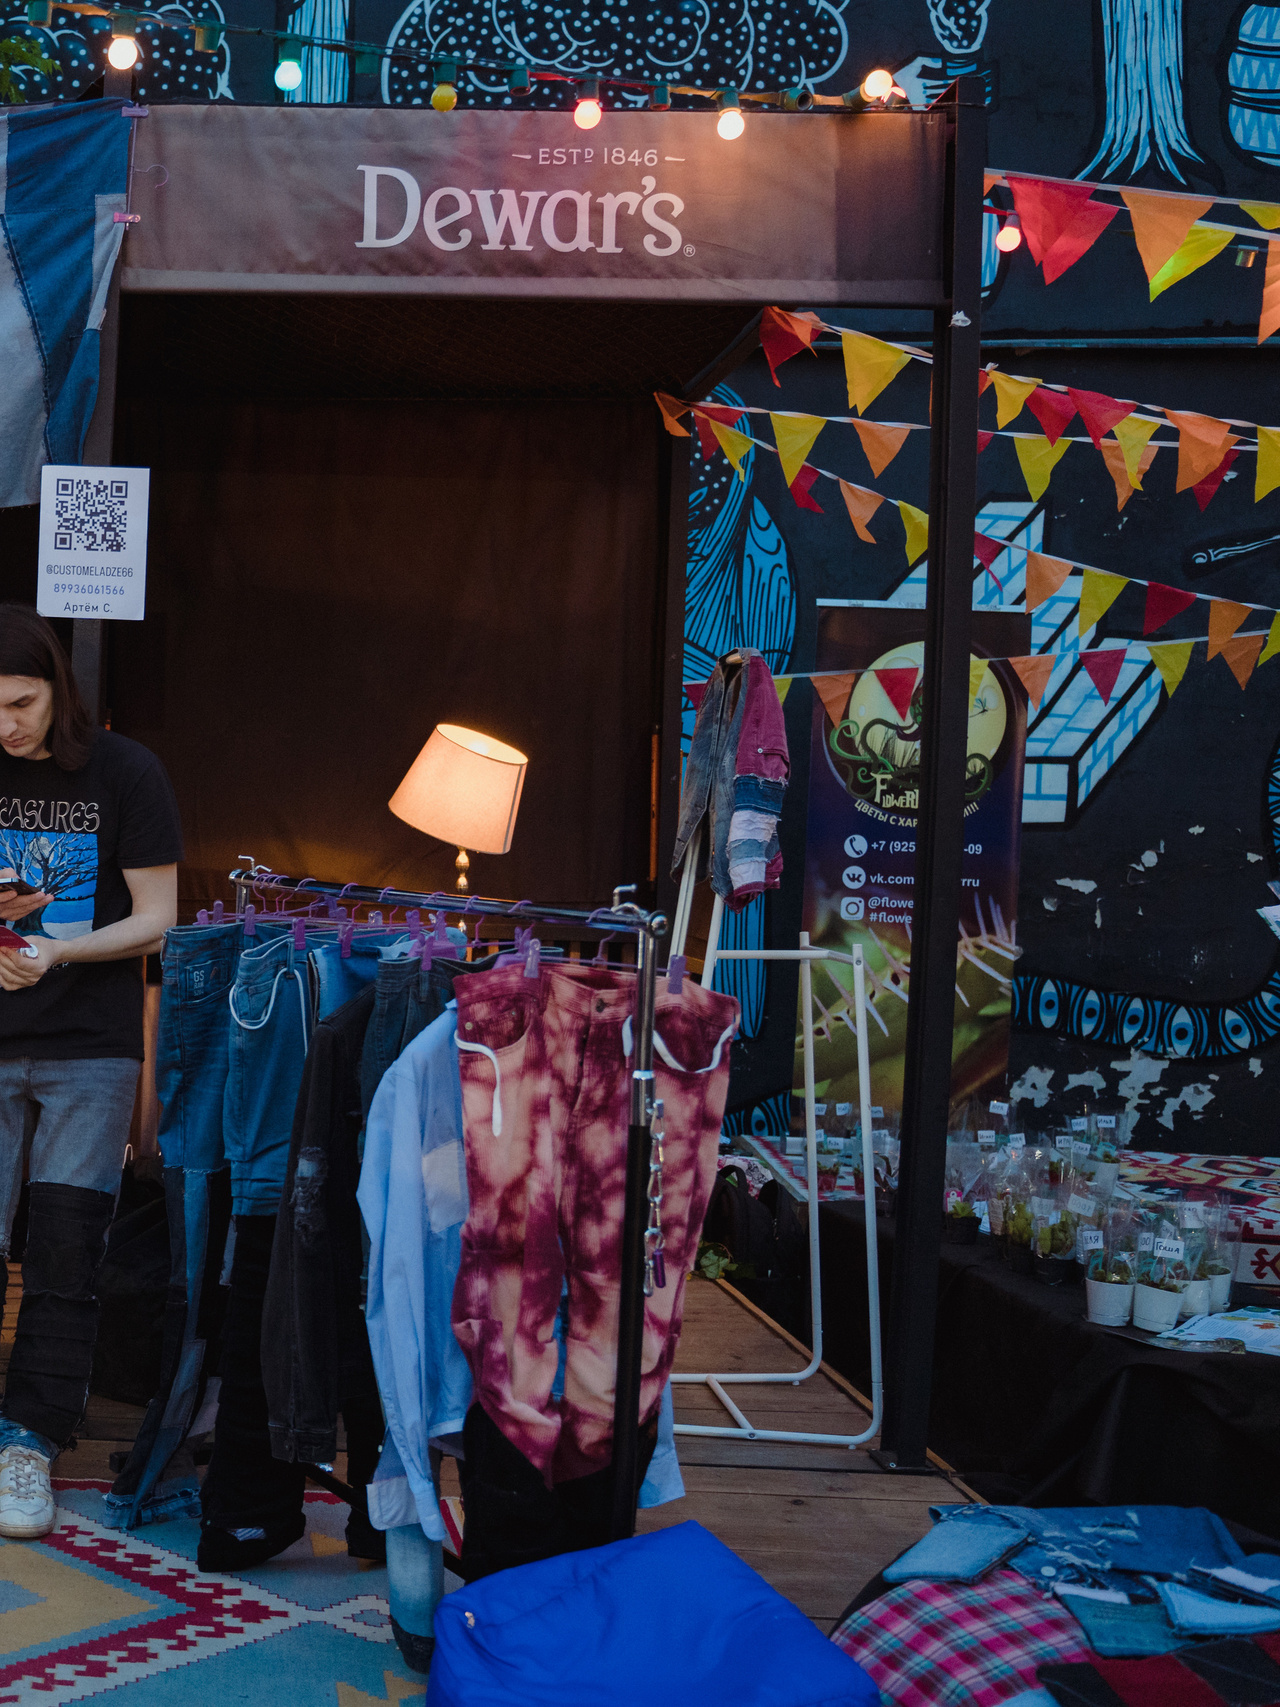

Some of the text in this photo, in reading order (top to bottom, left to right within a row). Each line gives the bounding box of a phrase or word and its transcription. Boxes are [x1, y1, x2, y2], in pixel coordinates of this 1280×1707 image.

[603, 147, 658, 166] 1846
[45, 564, 134, 578] @CUSTOMELADZE66
[53, 583, 125, 595] 89936061566
[63, 602, 113, 614] Артём С.
[854, 799, 889, 823] ЦВЕТЫ
[889, 815, 897, 825] С
[898, 817, 918, 828] ХАР
[871, 841, 983, 854] +7 (925 -09
[869, 873, 915, 884] vk.com
[868, 896, 914, 909] @flowe
[869, 912, 913, 924] #flowe
